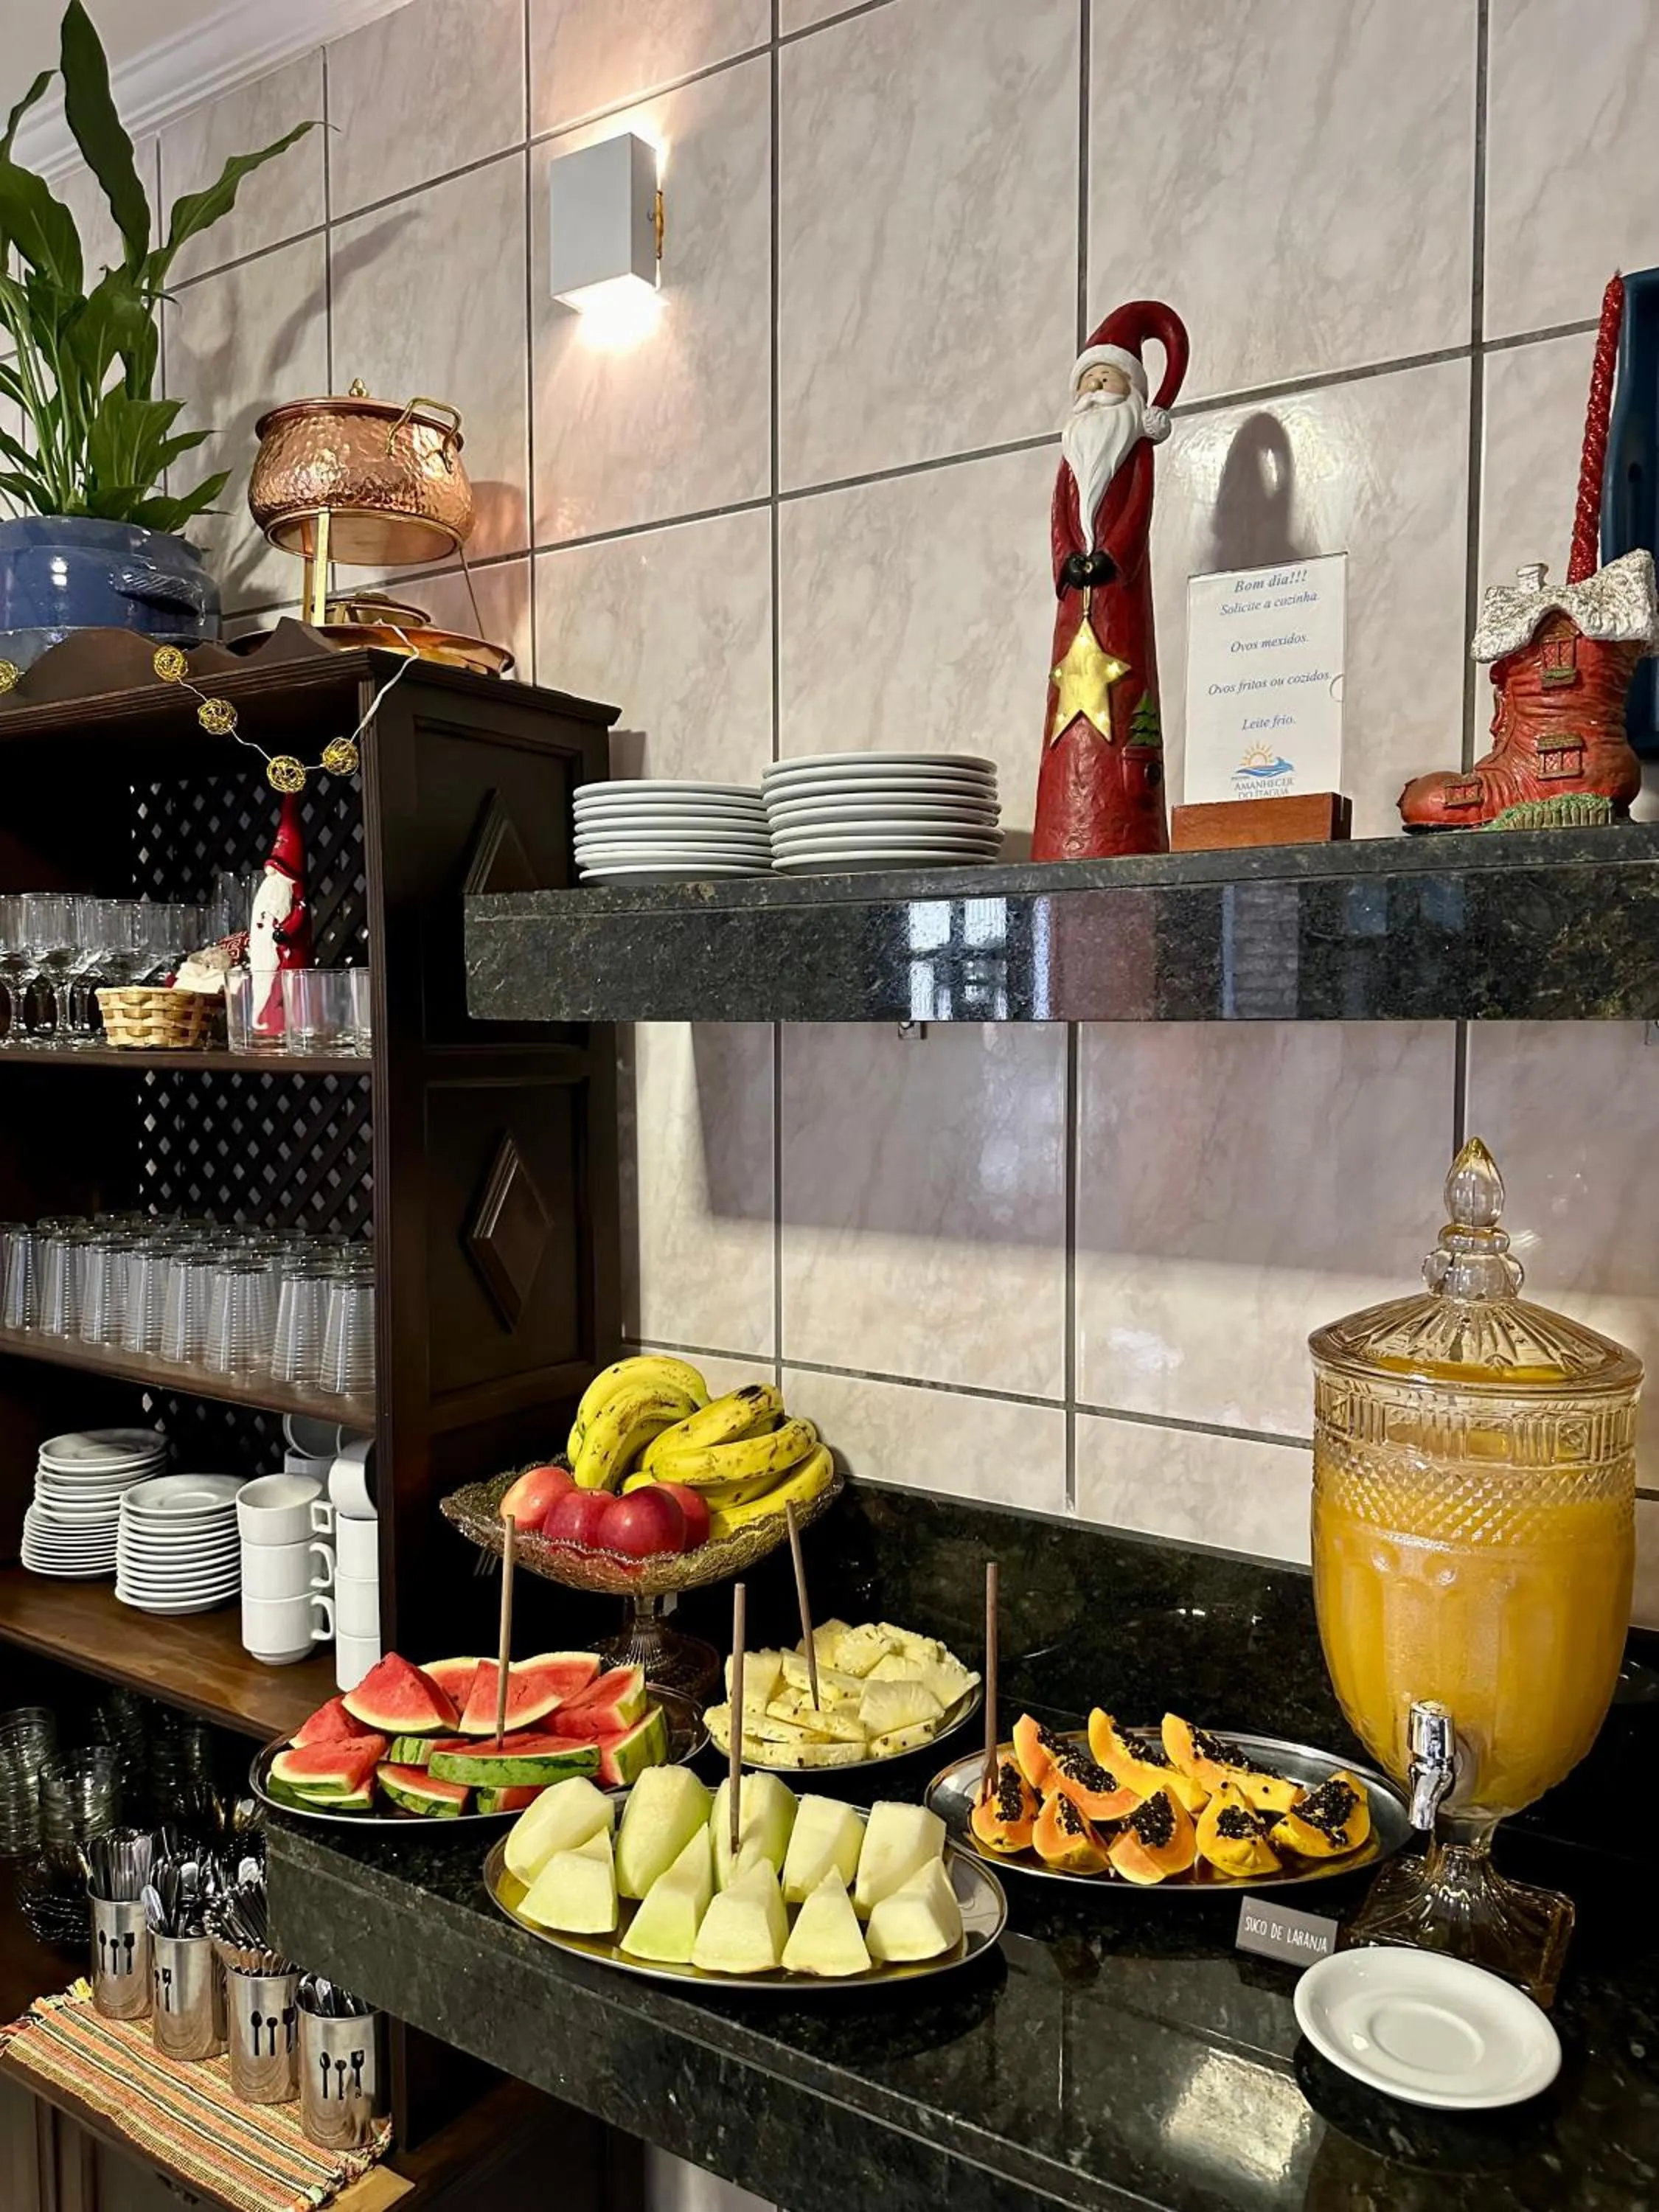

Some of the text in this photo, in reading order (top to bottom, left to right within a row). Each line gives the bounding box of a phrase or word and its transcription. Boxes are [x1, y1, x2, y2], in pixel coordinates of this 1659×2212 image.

[1234, 569, 1308, 593] Bom dia!!!
[1220, 602, 1262, 616] Solicite
[1263, 601, 1271, 609] a
[1231, 640, 1258, 653] Ovos
[1208, 684, 1235, 695] Ovos
[1236, 679, 1267, 695] fritos
[1270, 676, 1284, 686] ou
[1242, 718, 1270, 731] Leite
[1245, 1916, 1328, 1953] SUCO DE LARANJA
